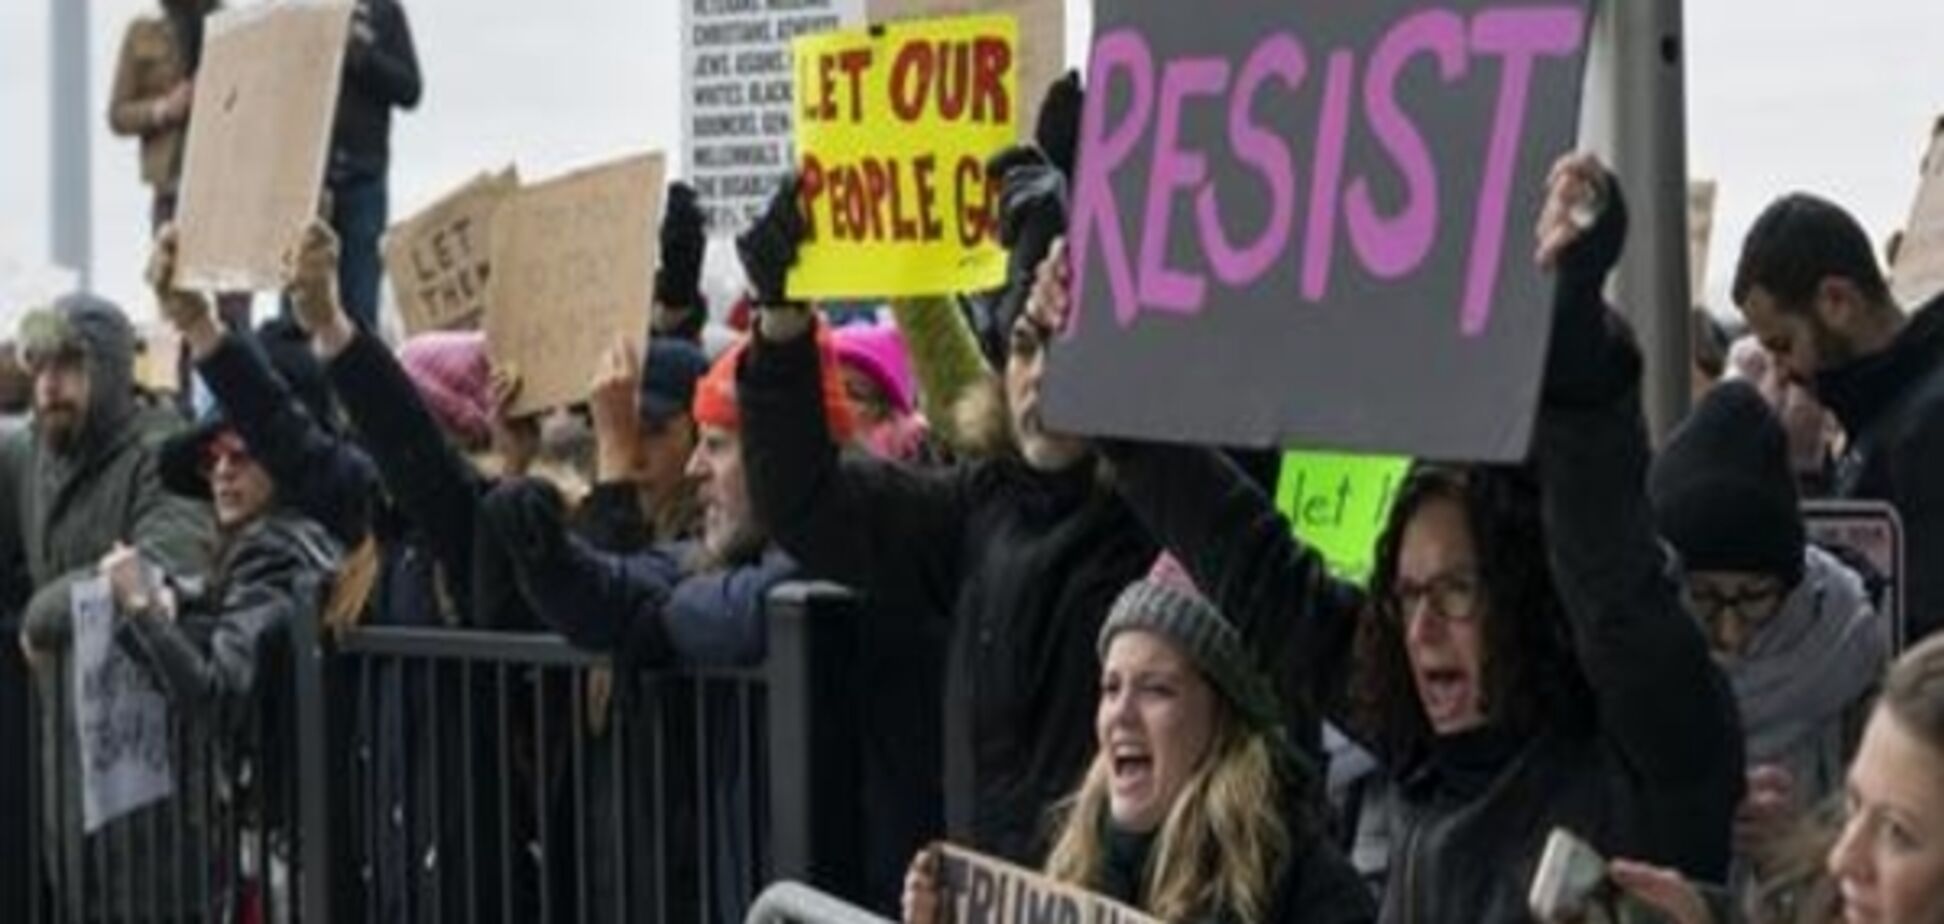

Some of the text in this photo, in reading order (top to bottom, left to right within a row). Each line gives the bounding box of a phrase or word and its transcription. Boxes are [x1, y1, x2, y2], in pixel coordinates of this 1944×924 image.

[804, 34, 1014, 125] LET OUR
[800, 152, 943, 243] PEOPLE
[1063, 8, 1587, 337] RESIST
[412, 217, 471, 281] LET
